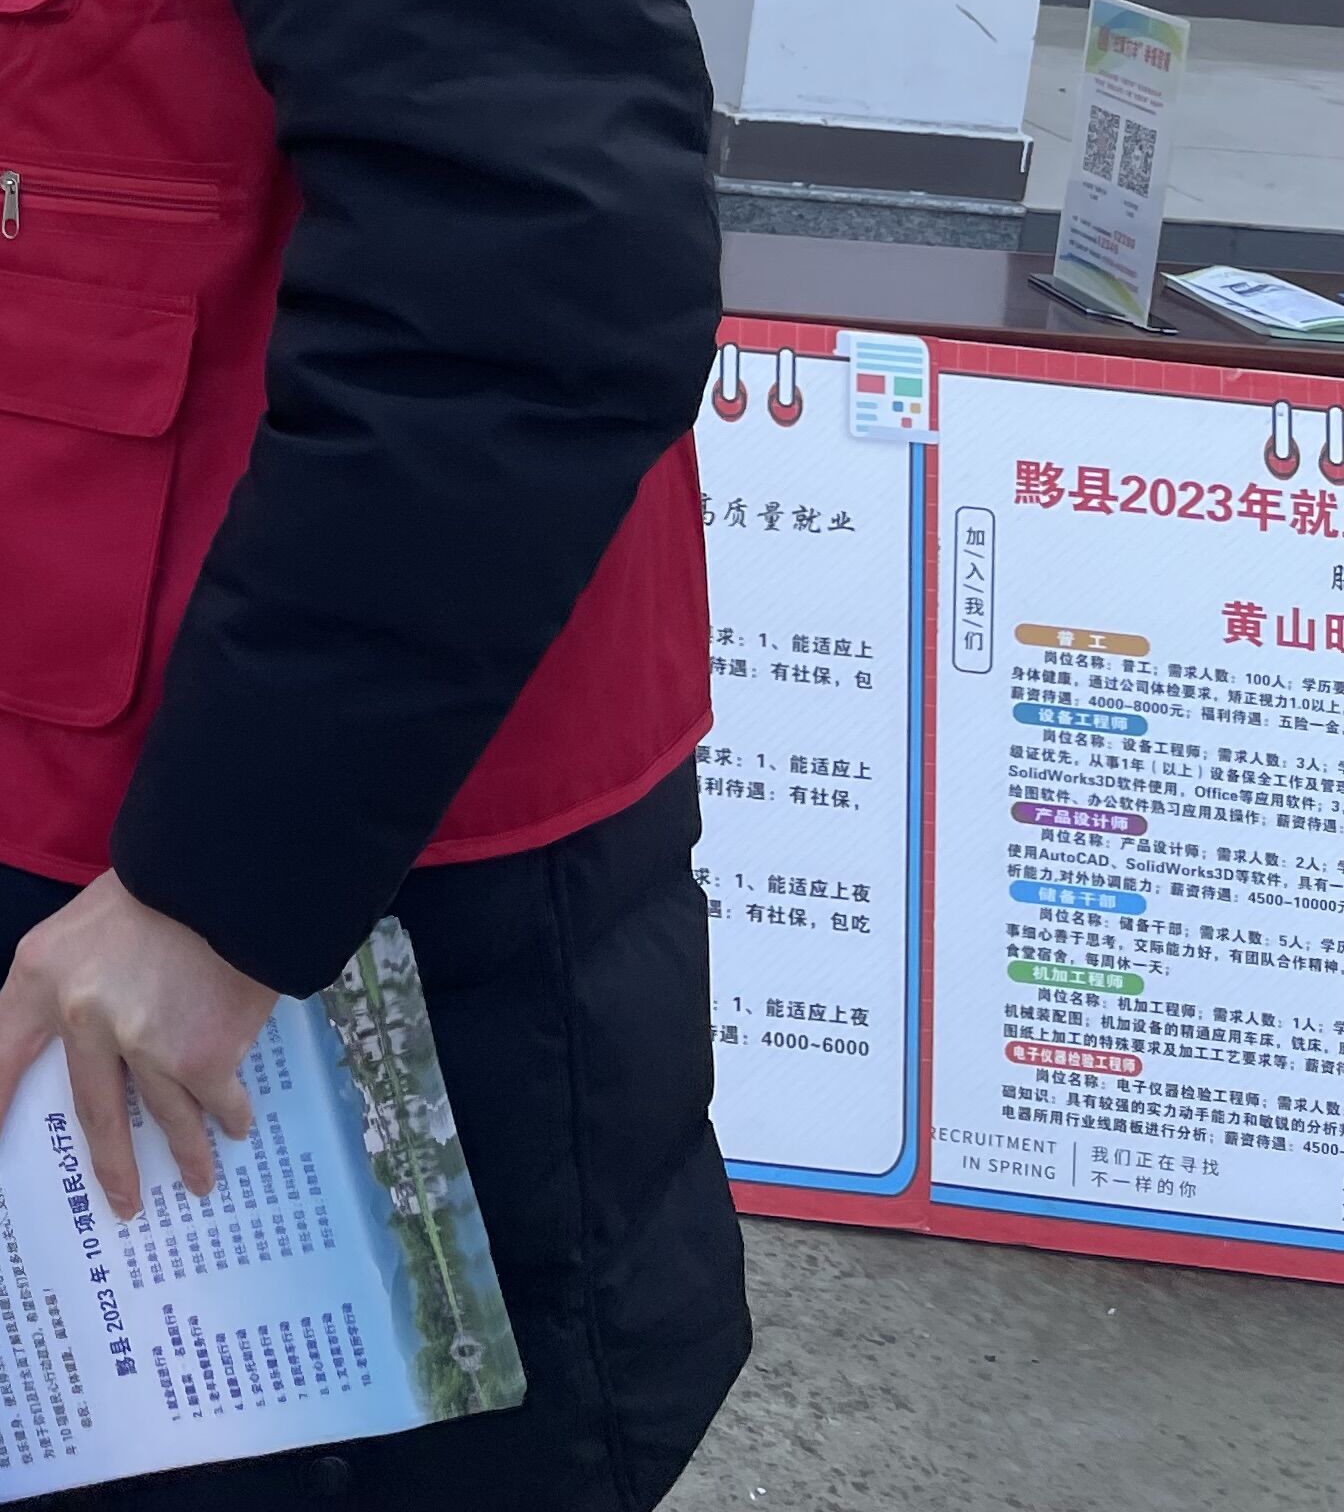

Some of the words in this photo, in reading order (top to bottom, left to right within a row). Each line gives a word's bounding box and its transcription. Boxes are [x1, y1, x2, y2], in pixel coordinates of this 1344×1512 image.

[1013, 460, 1344, 539] 黟县2023年就
[988, 1159, 1057, 1181] SPRING
